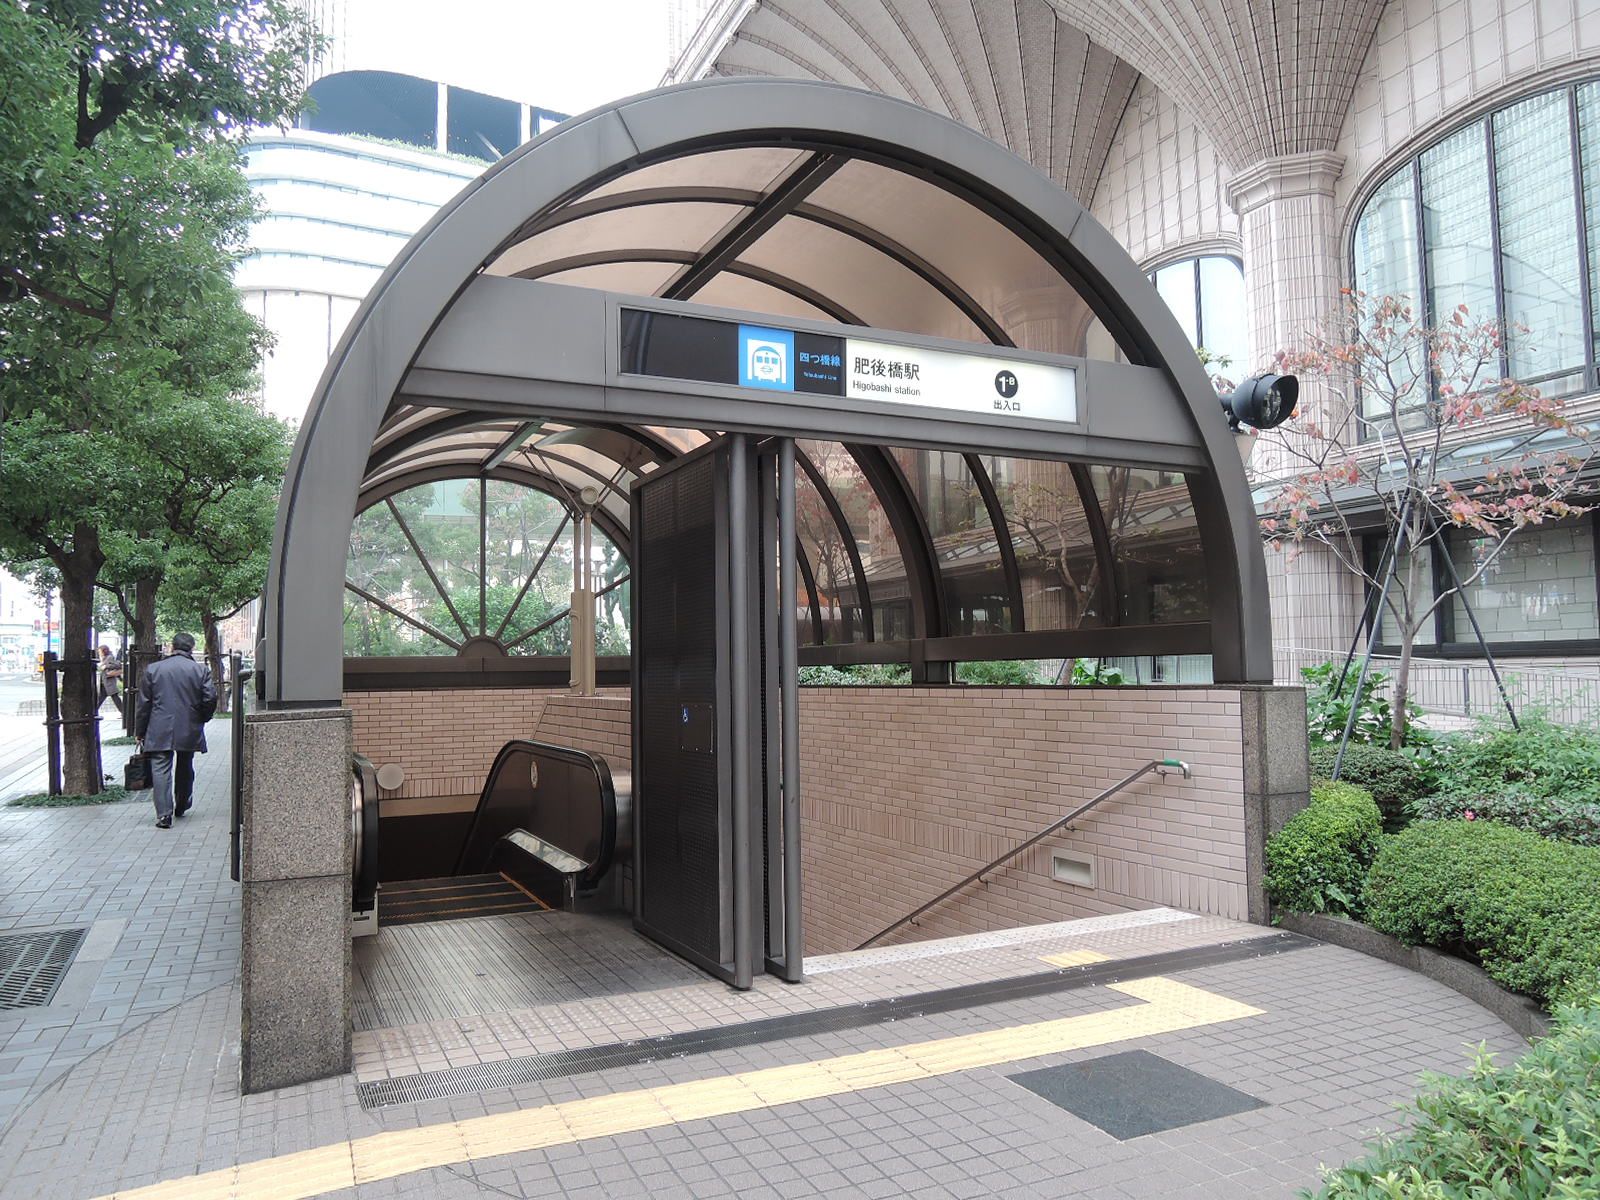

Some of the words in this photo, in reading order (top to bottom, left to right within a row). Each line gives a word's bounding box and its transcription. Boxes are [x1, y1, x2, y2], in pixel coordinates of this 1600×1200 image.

[799, 352, 841, 367] 四つ橋線
[854, 357, 920, 381] 肥後橋駅
[853, 380, 892, 393] Higobashi
[894, 386, 921, 397] station
[993, 400, 1021, 411] 出入口
